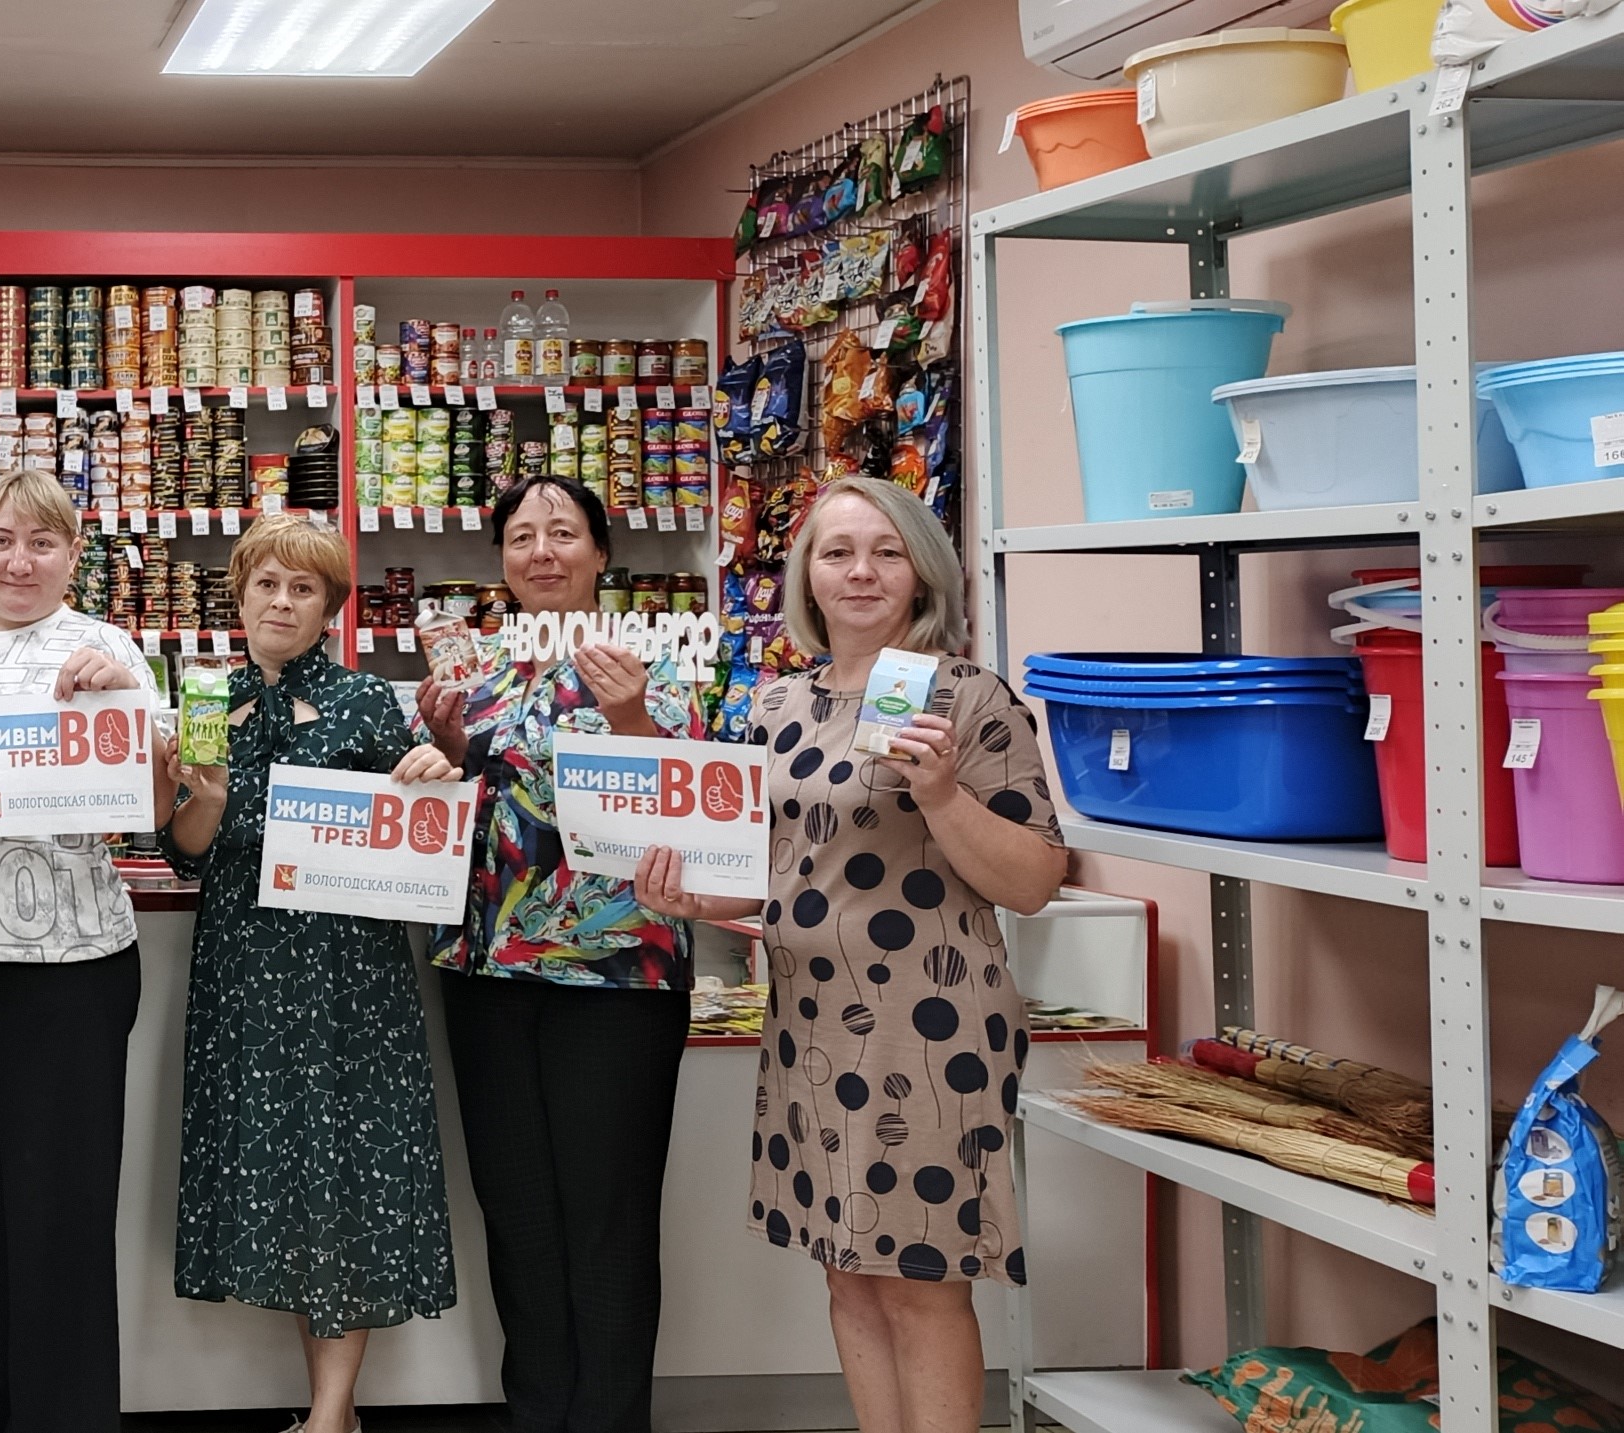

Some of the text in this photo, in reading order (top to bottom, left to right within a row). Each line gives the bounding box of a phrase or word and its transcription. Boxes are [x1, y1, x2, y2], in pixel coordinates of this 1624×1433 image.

[562, 767, 657, 793] ЖИВЕМ
[8, 793, 138, 810] ВОЛОГОДСКАЯ ОБЛАСТЬ
[274, 799, 370, 826] ЖИВЕМ
[706, 852, 753, 869] ОКРУГ
[304, 873, 449, 898] ВОЛОГОДСКАЯ ОБЛАСТЬ
